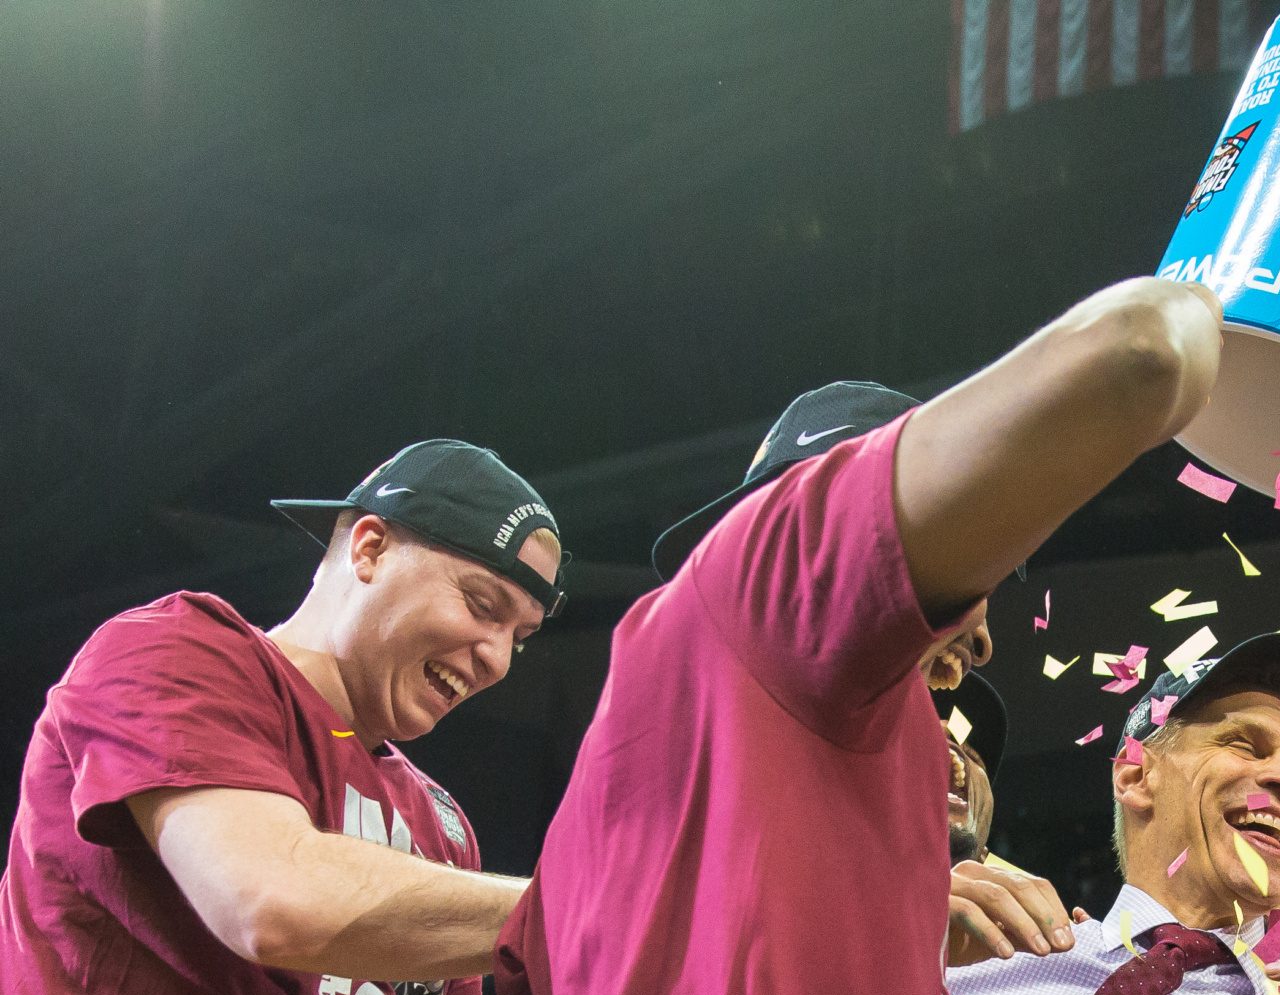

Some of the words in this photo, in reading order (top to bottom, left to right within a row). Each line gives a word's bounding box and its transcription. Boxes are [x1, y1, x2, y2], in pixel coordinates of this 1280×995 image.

[1257, 71, 1280, 93] TO
[1237, 87, 1276, 115] ROA
[493, 523, 515, 549] NCAA
